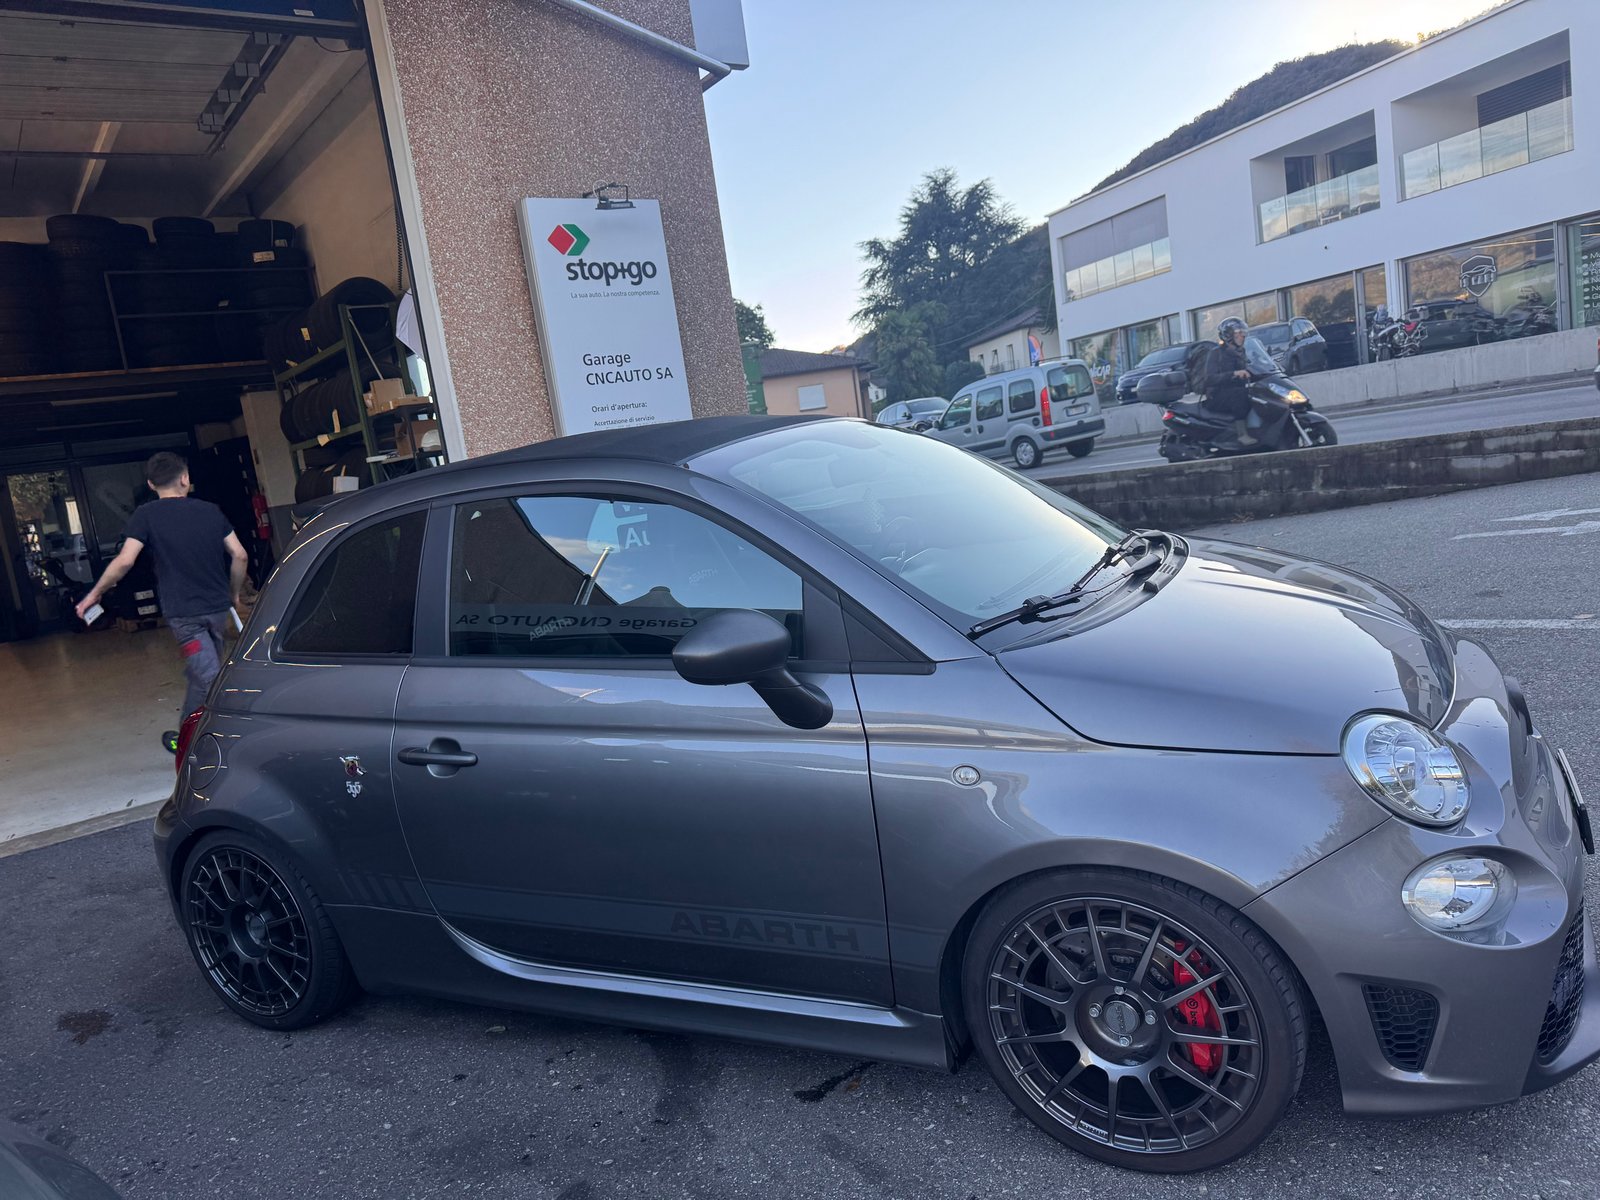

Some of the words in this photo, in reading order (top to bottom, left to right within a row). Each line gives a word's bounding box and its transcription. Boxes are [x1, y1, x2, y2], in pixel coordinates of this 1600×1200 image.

[566, 258, 657, 286] stop+go
[583, 353, 631, 367] Garage
[586, 369, 652, 386] CNCAUTO
[656, 367, 674, 380] SA
[592, 404, 609, 413] Orari
[594, 418, 628, 426] Accettazione
[528, 617, 574, 641] ABARTH
[671, 911, 860, 952] ABARTH
